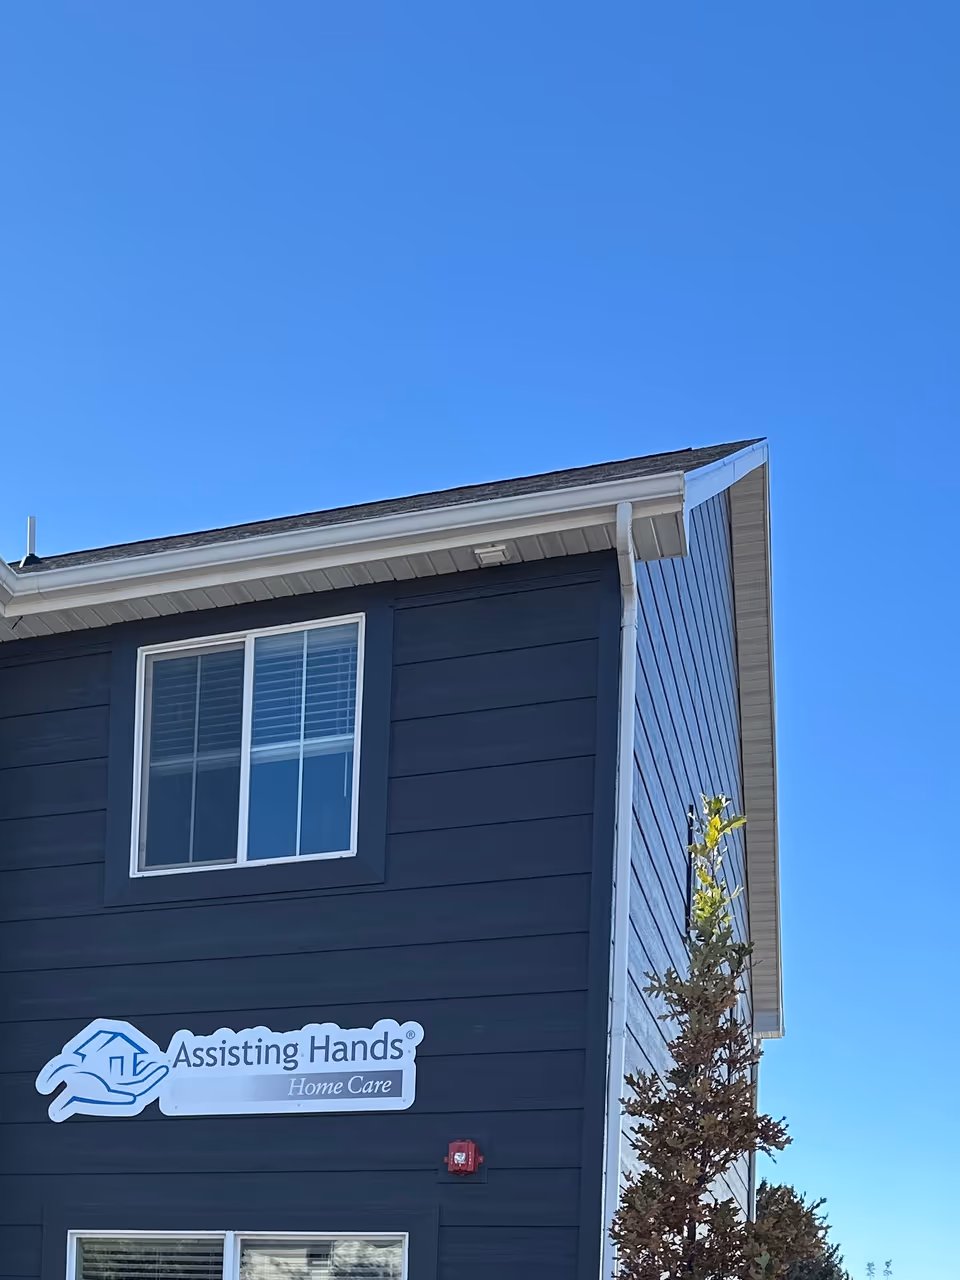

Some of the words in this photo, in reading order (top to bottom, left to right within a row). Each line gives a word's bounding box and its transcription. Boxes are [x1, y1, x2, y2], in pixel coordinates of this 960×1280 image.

[172, 1037, 299, 1071] Assisting
[288, 1077, 343, 1096] Home
[347, 1075, 392, 1094] Care
